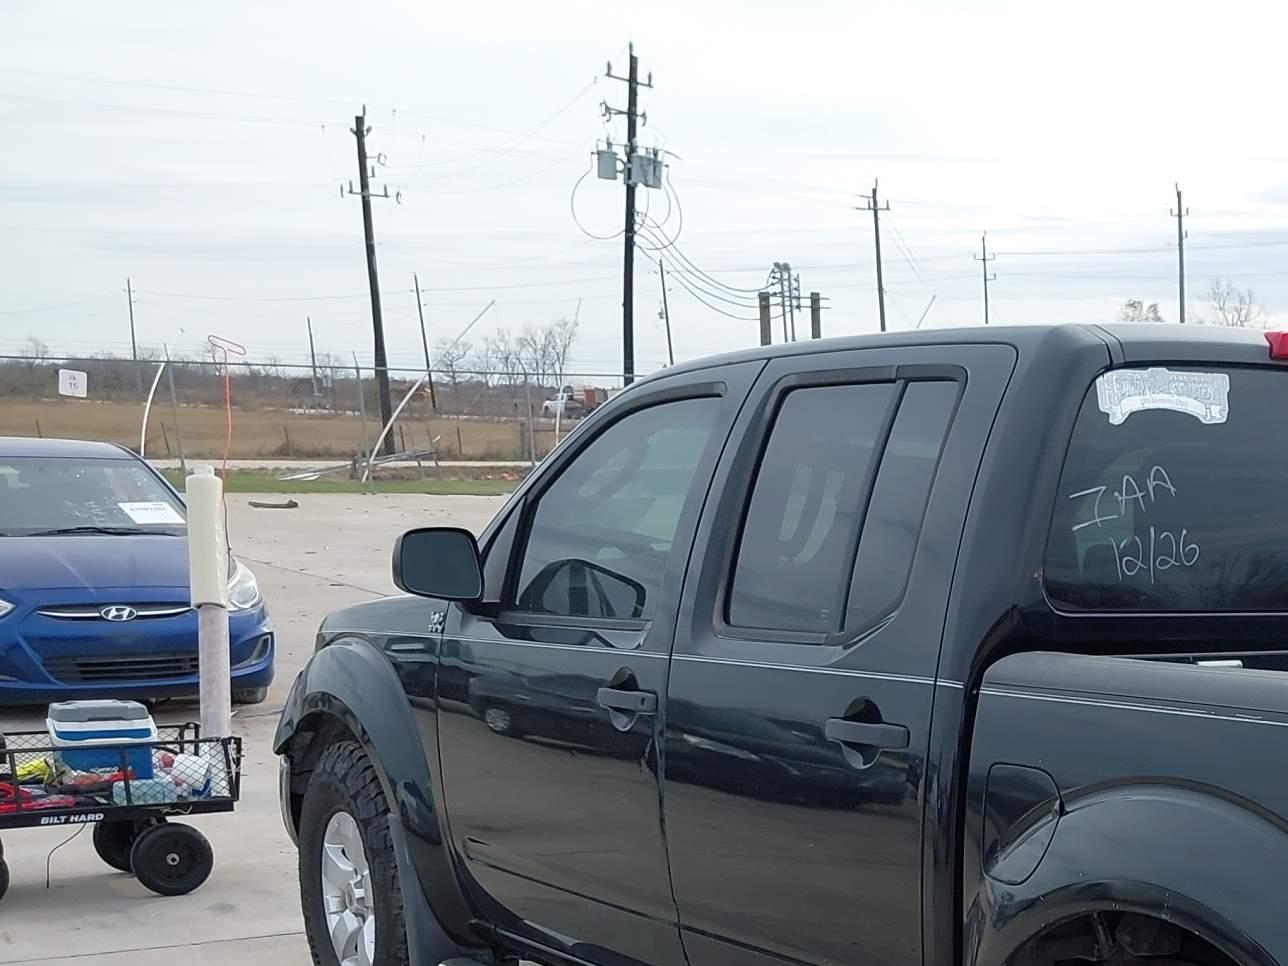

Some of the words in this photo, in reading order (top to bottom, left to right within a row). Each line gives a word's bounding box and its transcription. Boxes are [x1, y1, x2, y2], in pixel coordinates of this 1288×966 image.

[1109, 526, 1200, 584] 12/26
[41, 816, 67, 825] BILT
[70, 813, 104, 823] HARD
